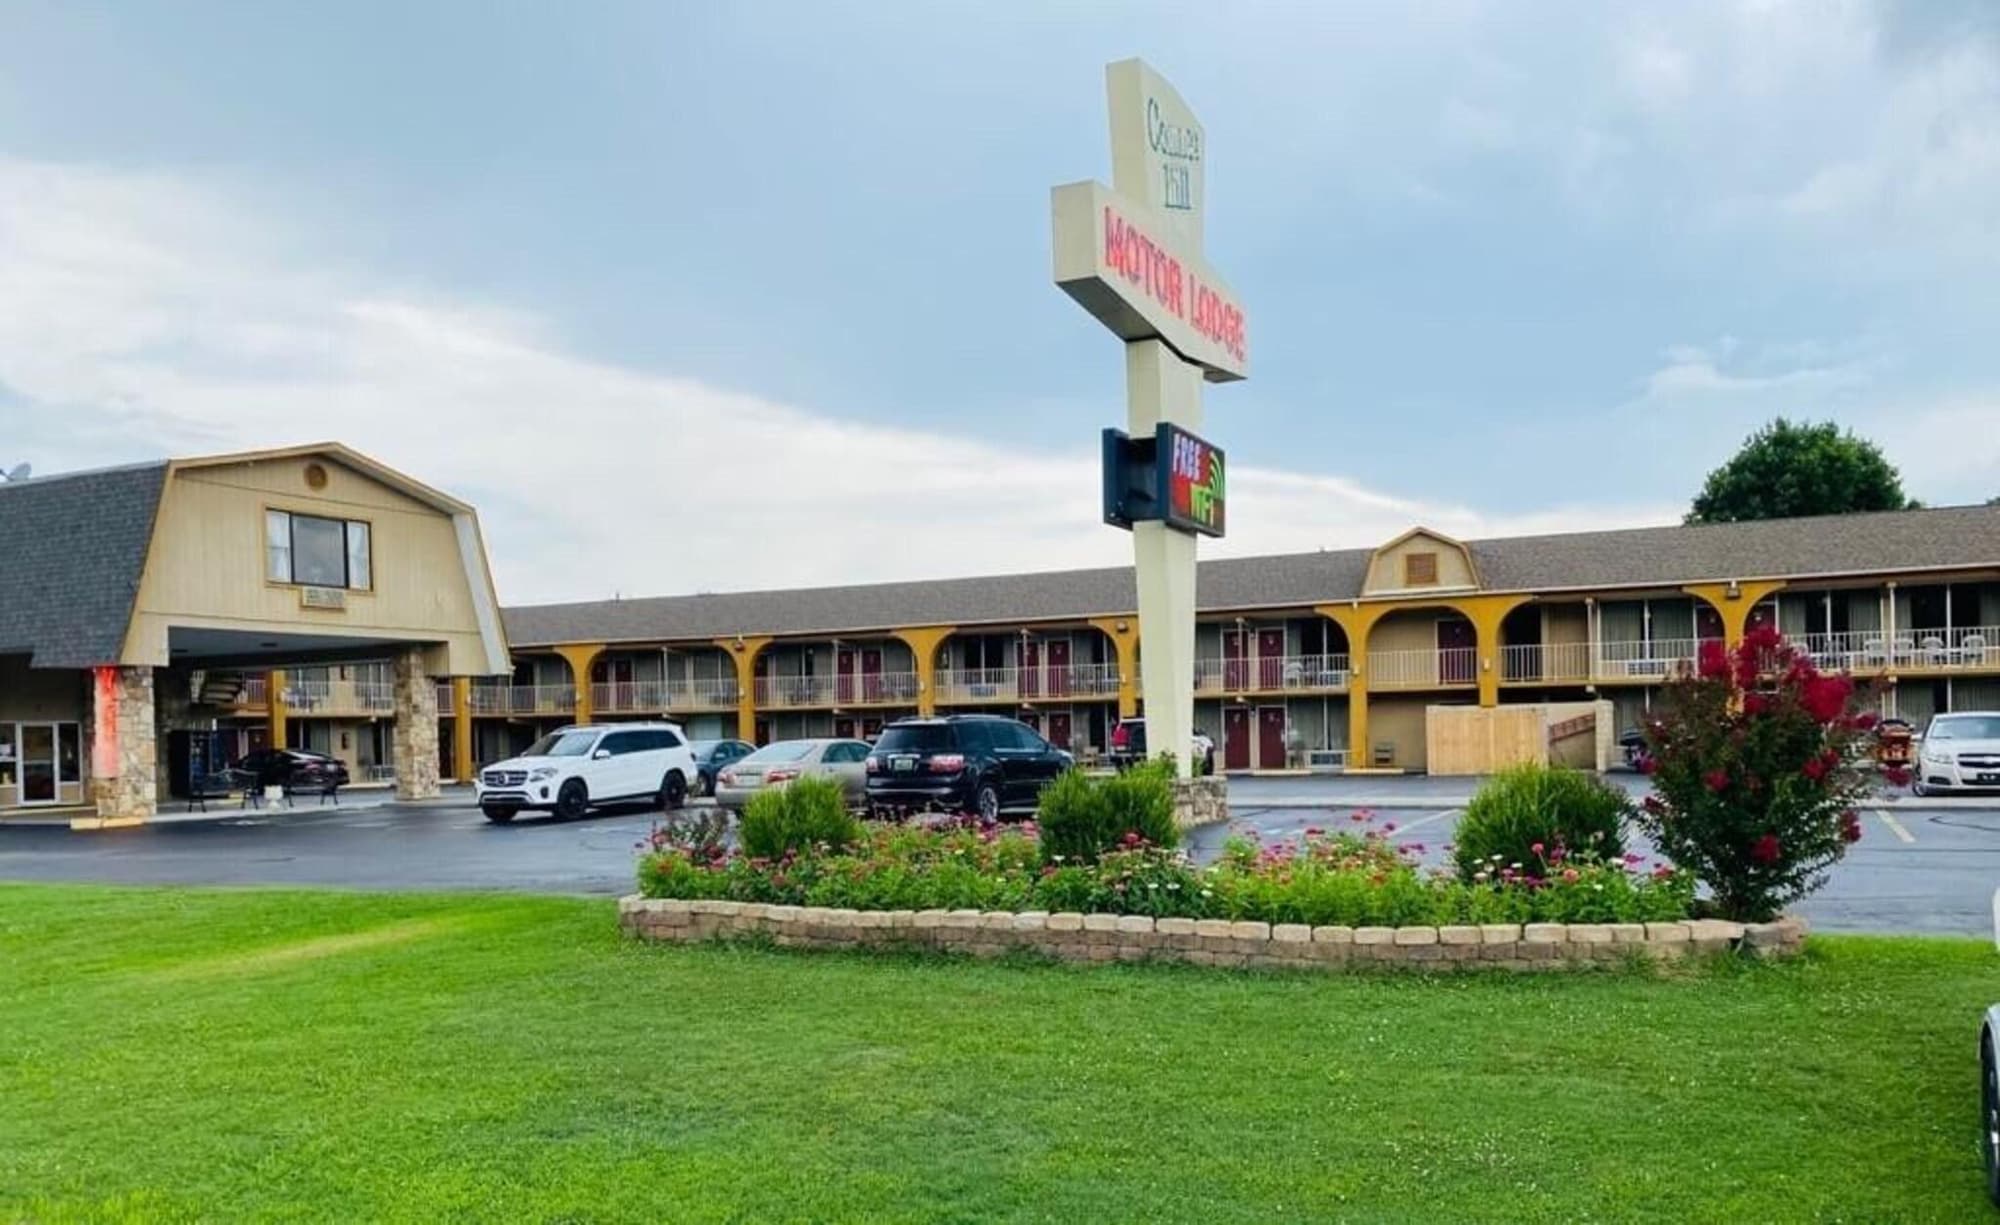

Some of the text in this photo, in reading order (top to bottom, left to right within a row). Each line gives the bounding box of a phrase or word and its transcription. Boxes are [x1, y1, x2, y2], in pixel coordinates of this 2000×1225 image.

[1104, 206, 1245, 362] MOTOR LODGE
[1173, 433, 1201, 481] FREE
